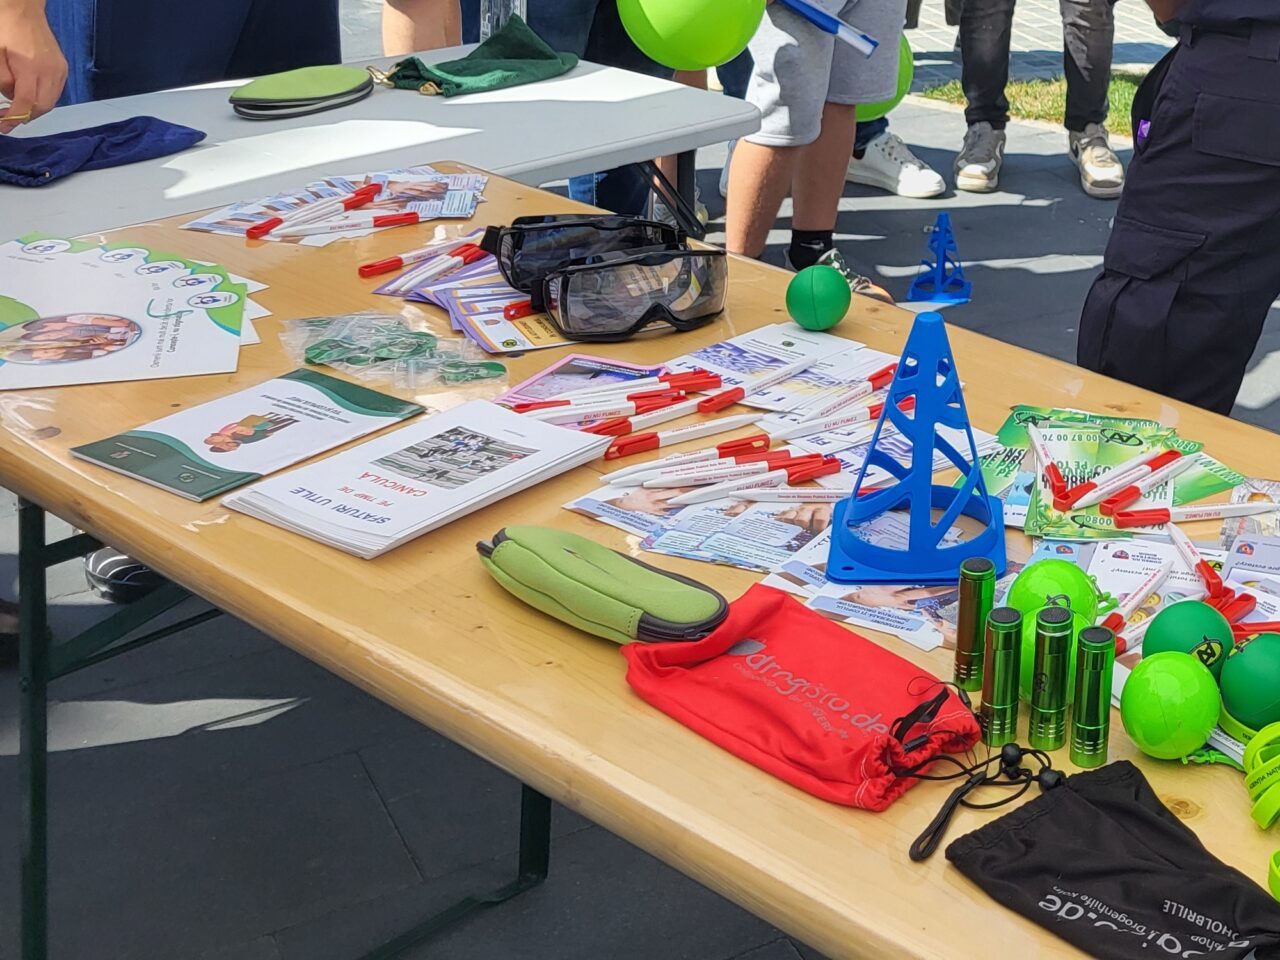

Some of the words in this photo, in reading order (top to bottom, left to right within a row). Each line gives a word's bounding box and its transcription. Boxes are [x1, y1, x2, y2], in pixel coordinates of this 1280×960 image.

[337, 486, 353, 495] DE
[357, 471, 427, 499] CANICULĂ
[289, 487, 331, 507] UTILE
[355, 491, 377, 504] TIMP
[380, 499, 393, 508] PE
[334, 503, 390, 525] SFATURI
[1080, 893, 1148, 934] Drogenhilfe
